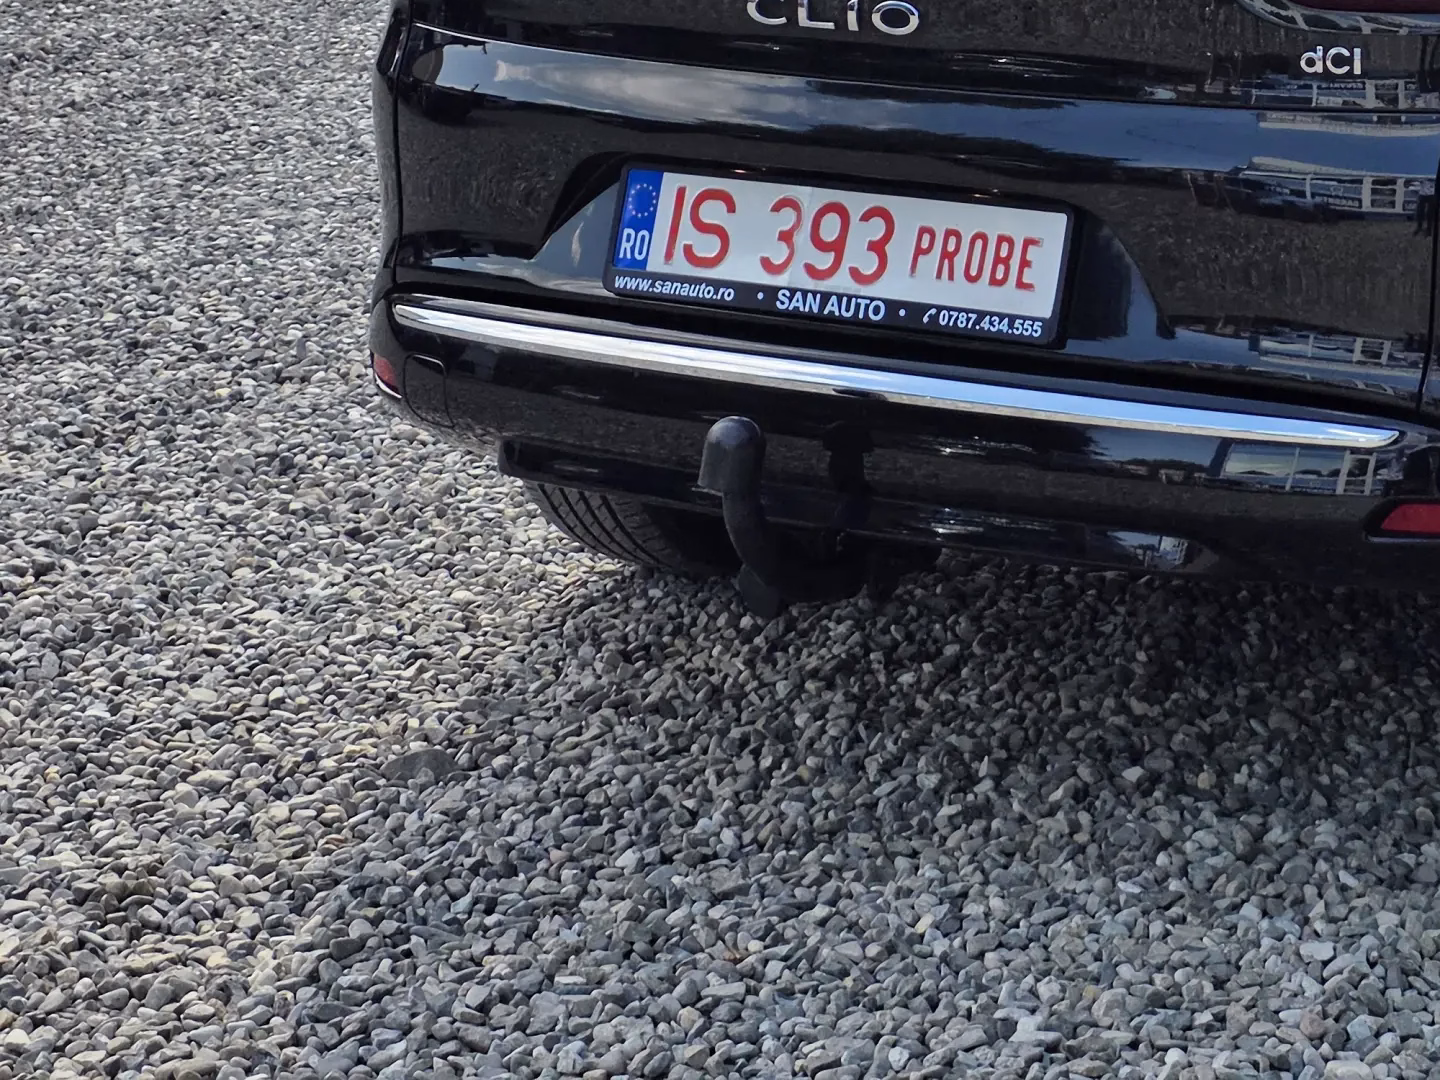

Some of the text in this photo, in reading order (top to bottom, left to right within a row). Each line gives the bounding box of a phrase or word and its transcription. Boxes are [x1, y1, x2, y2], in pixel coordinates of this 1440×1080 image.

[619, 228, 648, 261] RO
[663, 185, 1044, 292] IS 393 PROBE
[614, 276, 1043, 338] www.sanauto.ro SAN AUTO 0787.434.555
